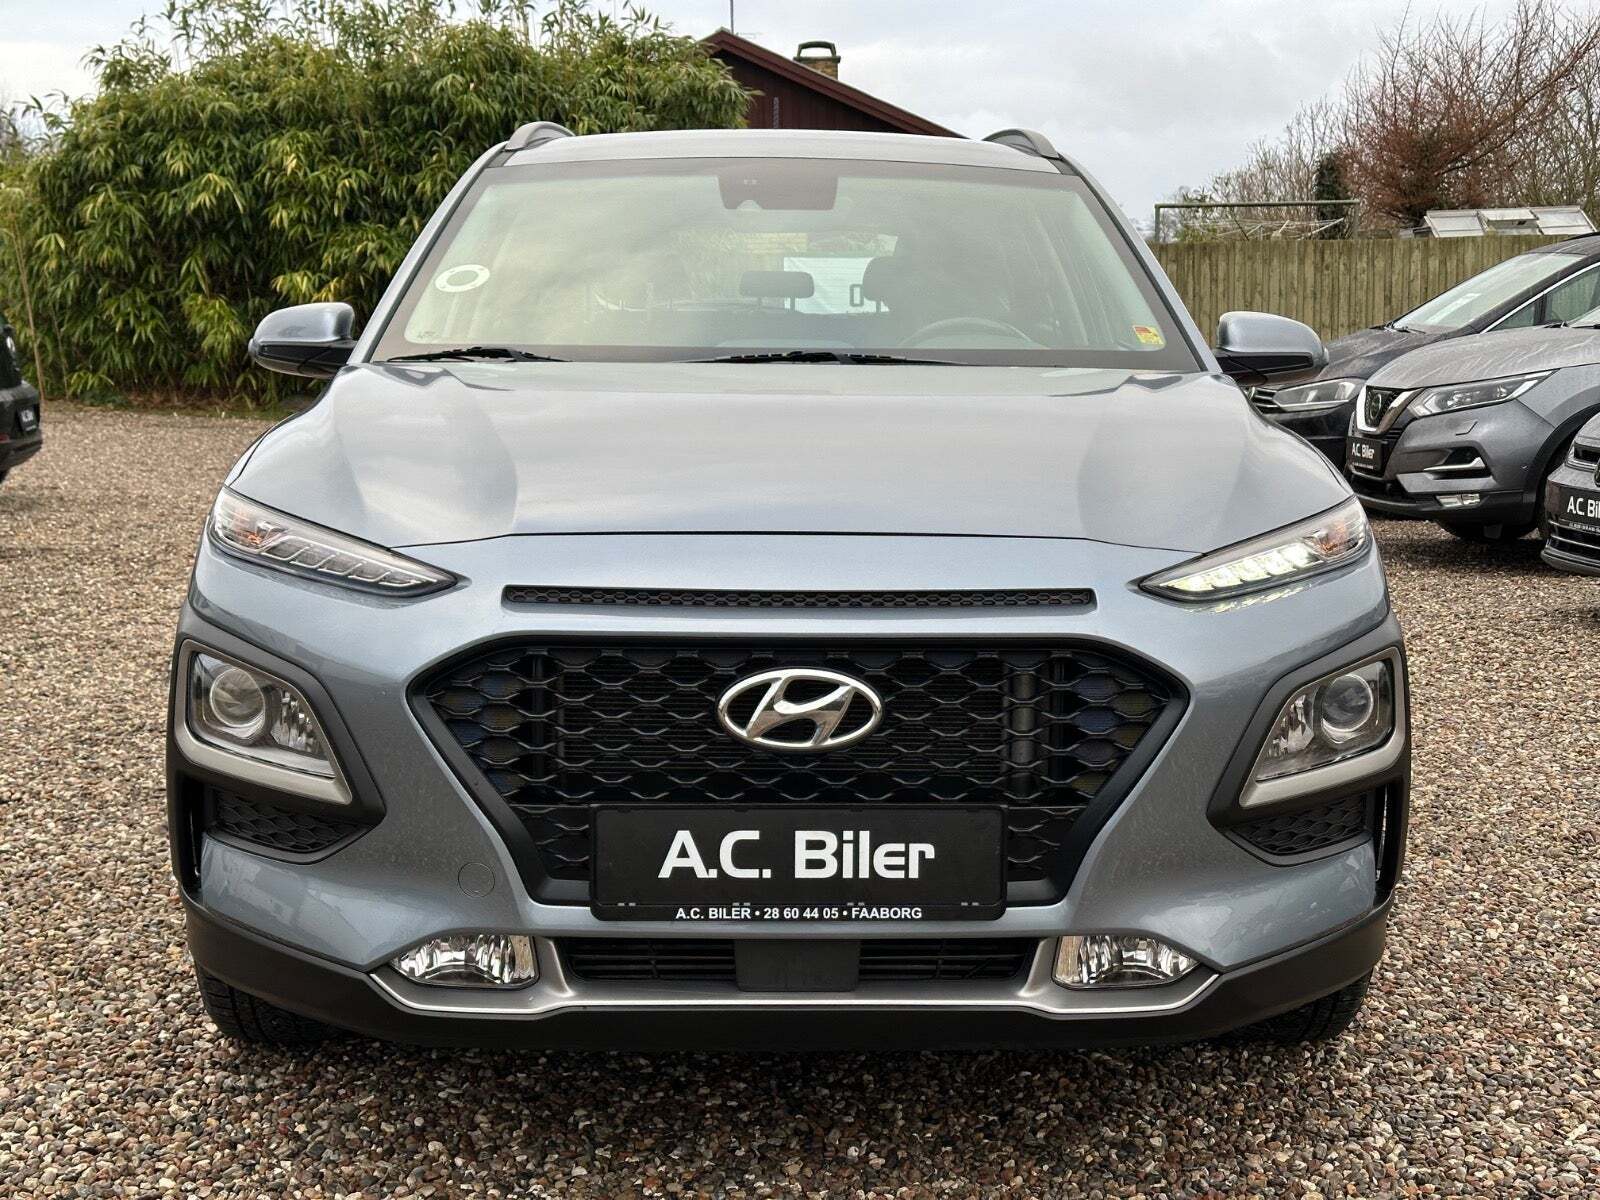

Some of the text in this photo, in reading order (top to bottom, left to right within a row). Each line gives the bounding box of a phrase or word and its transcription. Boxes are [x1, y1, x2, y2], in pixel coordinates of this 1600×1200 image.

[658, 830, 935, 879] A.C. Biler
[676, 907, 923, 919] A.C. BILER 28 60 44 05 FAABORG
